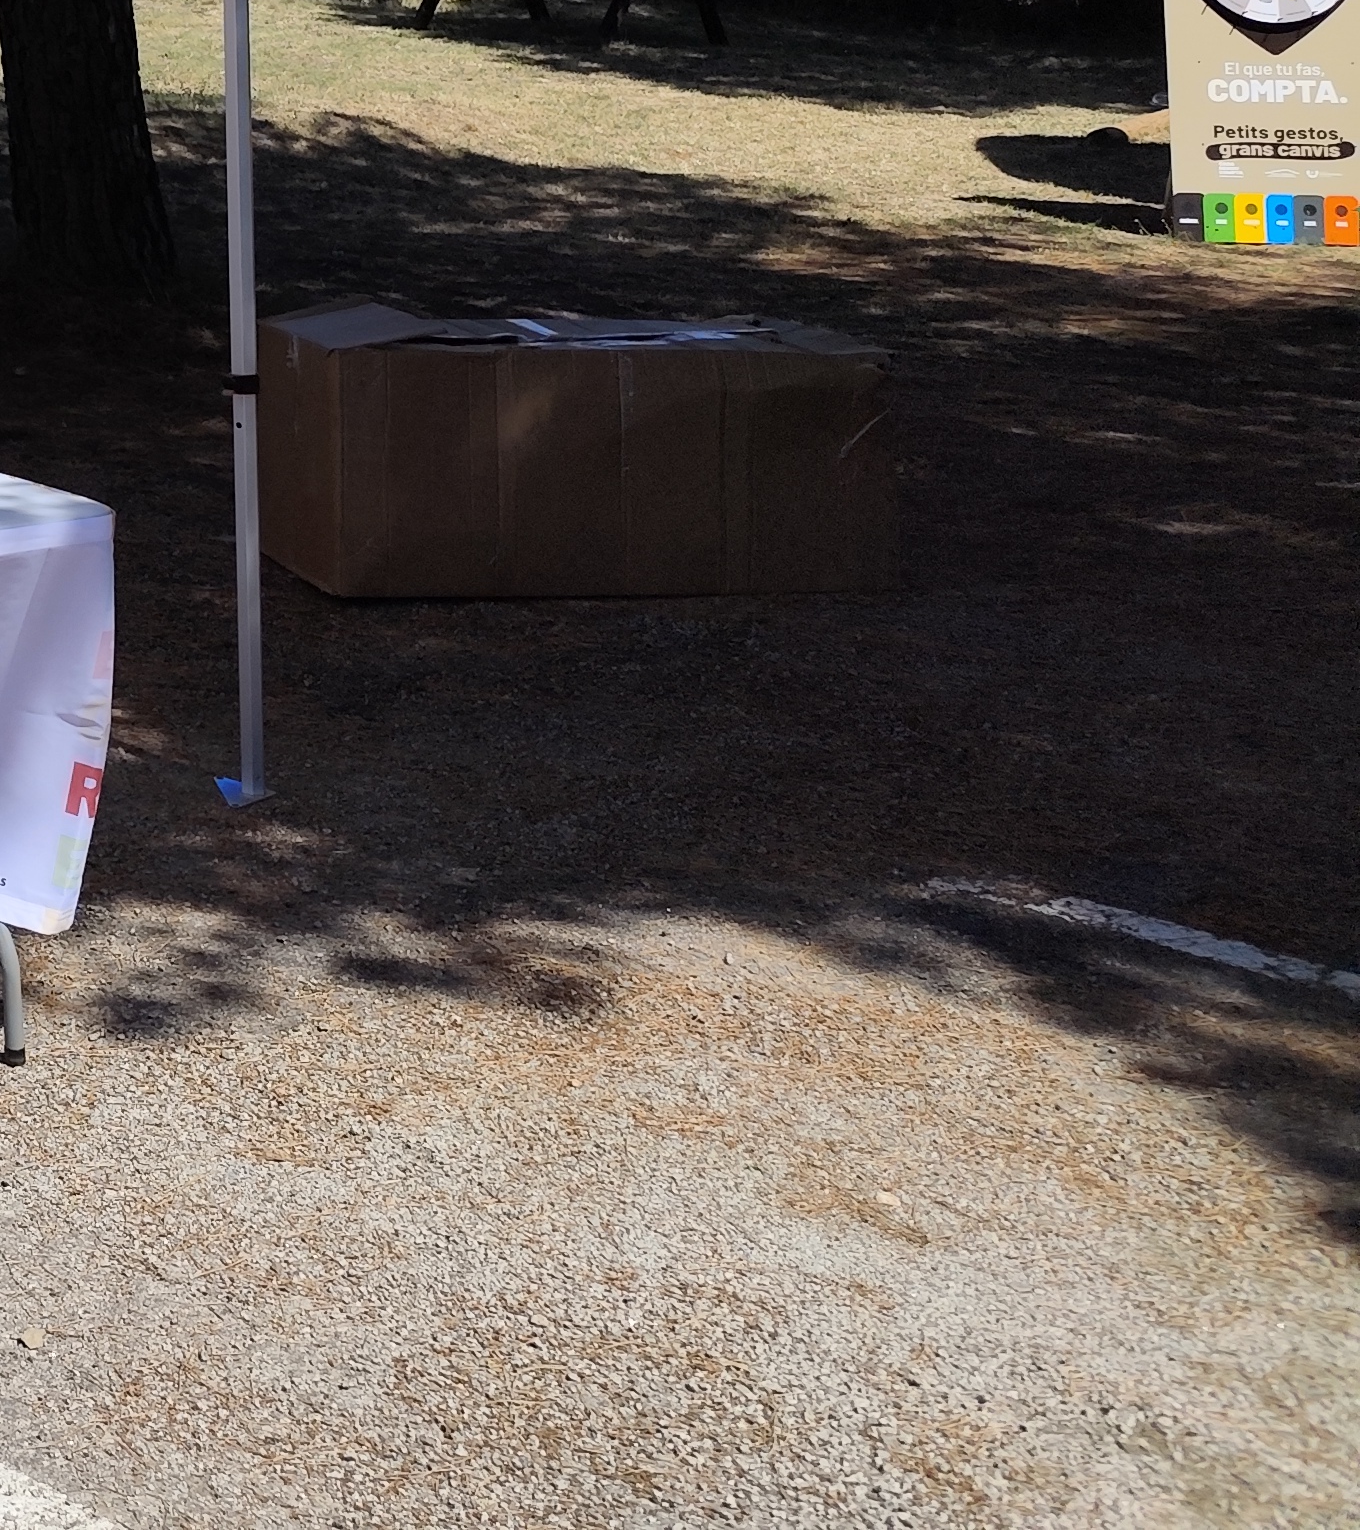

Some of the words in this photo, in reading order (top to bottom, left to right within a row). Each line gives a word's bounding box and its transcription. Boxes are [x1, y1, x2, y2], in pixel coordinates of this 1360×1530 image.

[1224, 62, 1240, 75] El
[1243, 65, 1273, 77] que
[1276, 63, 1293, 76] tu
[1296, 62, 1325, 77] fas,
[1207, 78, 1348, 104] COMPTA.
[1213, 125, 1269, 139] Petits
[1274, 127, 1344, 143] gestos,
[1219, 144, 1275, 158] grans
[1277, 144, 1341, 157] canvis
